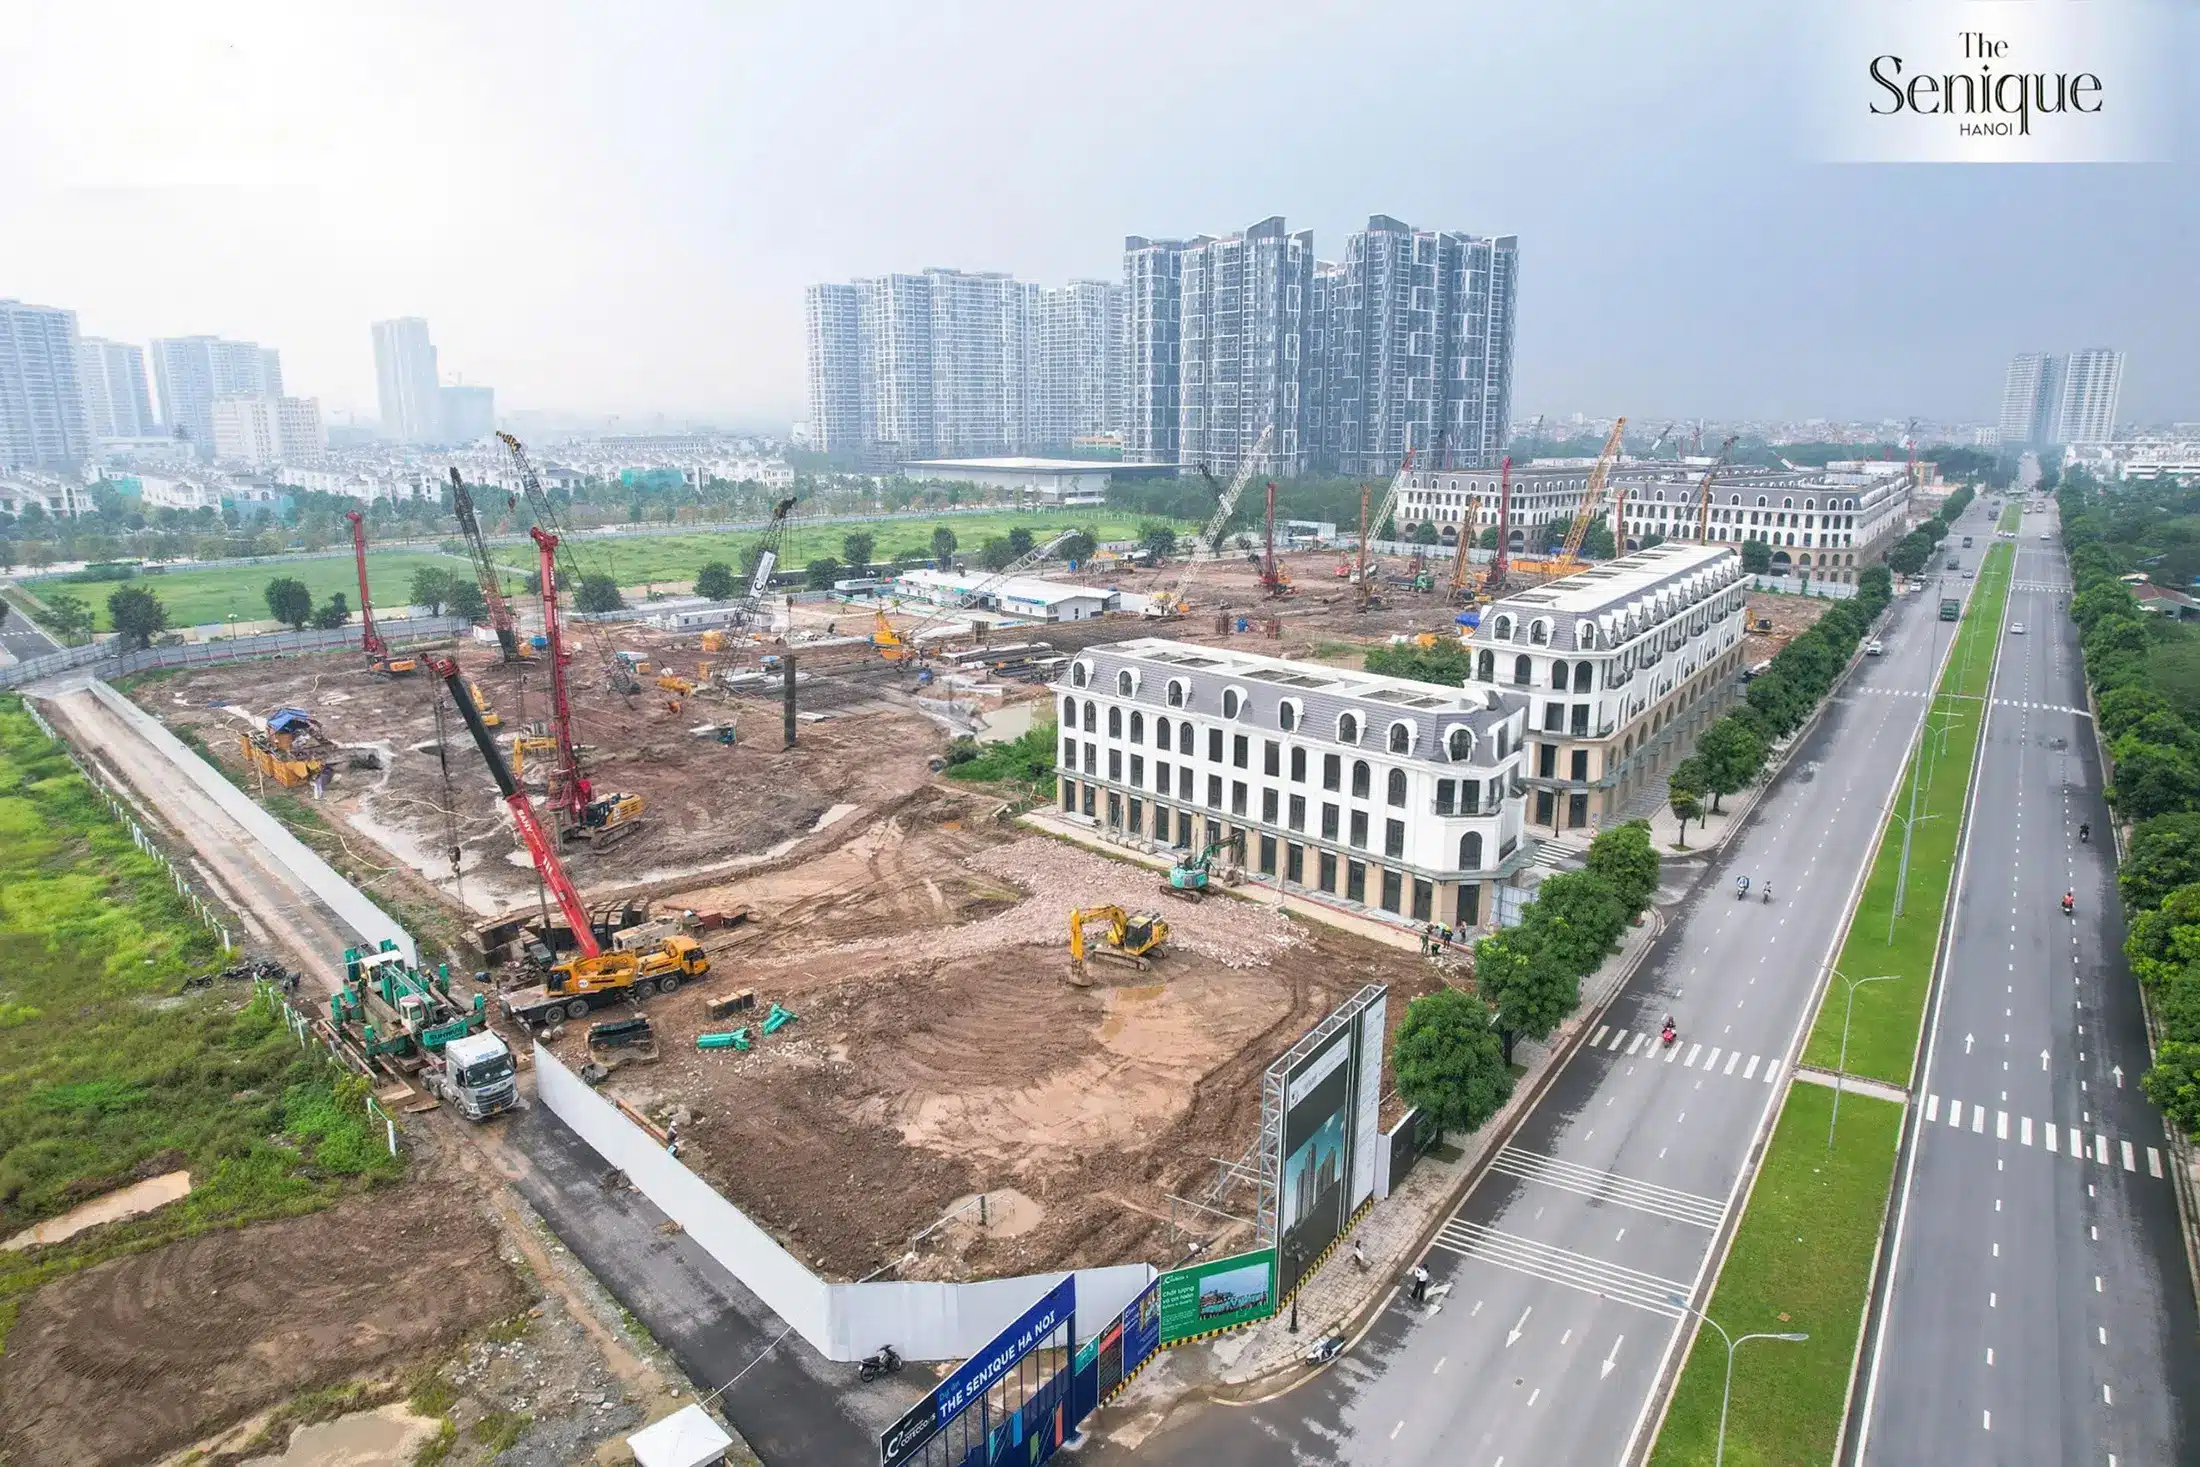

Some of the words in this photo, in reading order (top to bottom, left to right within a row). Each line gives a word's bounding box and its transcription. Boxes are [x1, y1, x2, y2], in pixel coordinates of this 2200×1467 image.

[940, 1390, 963, 1418] THE
[966, 1344, 1016, 1397] SENIQUE
[1018, 1331, 1033, 1352] HA
[1035, 1310, 1055, 1337] NOI
[900, 1412, 937, 1447] COTECCOS
